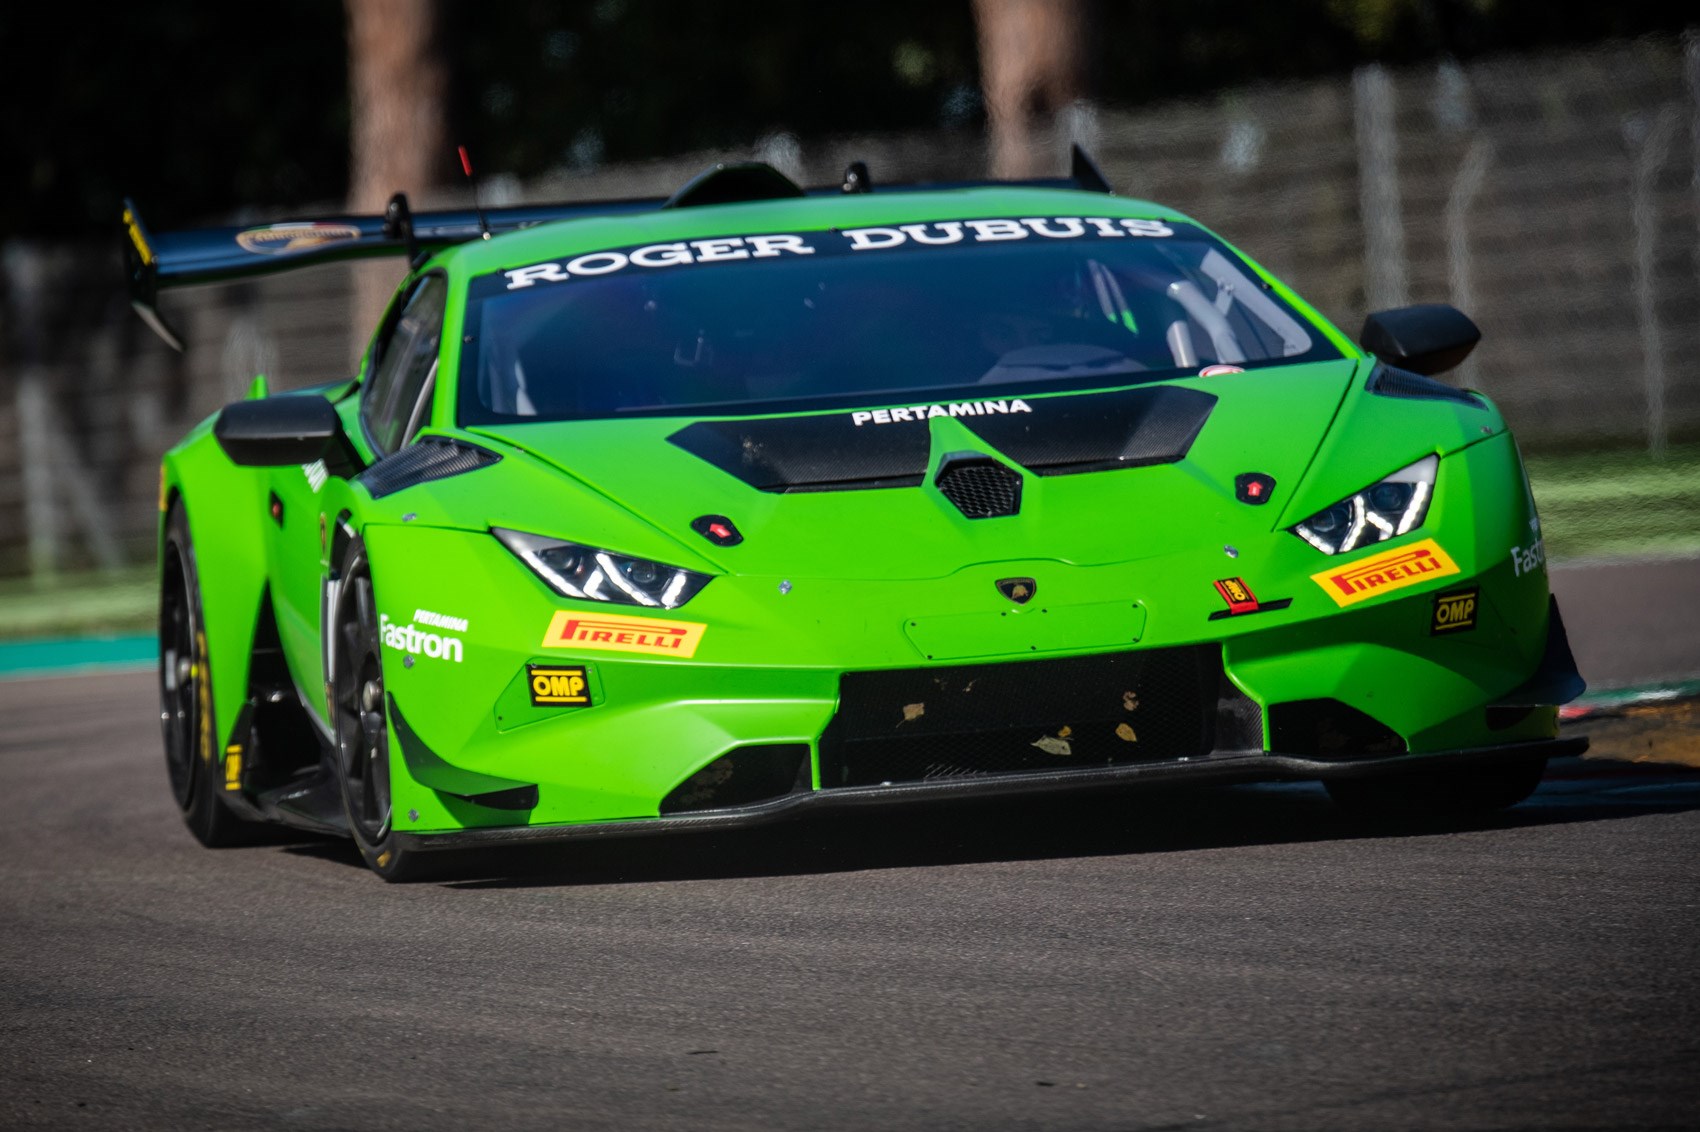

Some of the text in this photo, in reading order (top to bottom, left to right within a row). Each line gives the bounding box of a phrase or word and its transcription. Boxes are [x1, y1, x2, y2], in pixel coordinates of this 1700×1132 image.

[504, 217, 1174, 290] ROGER DUBUIS
[852, 399, 1033, 426] PERTAMINA
[1330, 549, 1442, 596] PIRELLI
[1225, 580, 1246, 601] OMP
[413, 608, 468, 632] PERTAMINA
[1436, 599, 1474, 624] OMP
[380, 613, 463, 663] Fastron
[560, 619, 688, 649] PIRELLI
[533, 675, 585, 696] OMP
